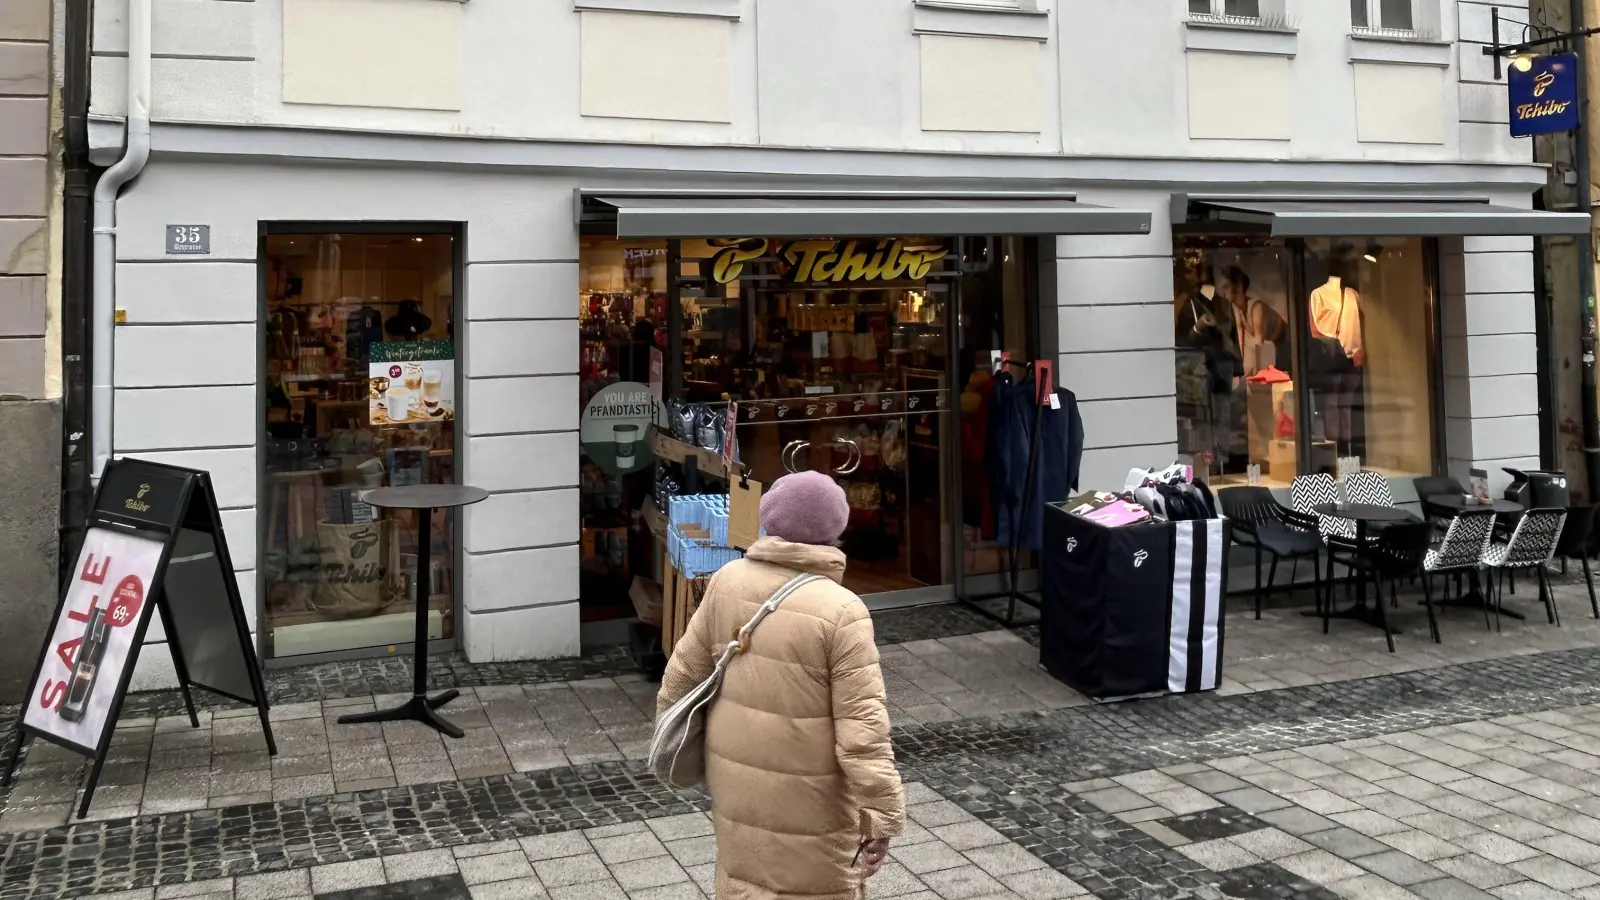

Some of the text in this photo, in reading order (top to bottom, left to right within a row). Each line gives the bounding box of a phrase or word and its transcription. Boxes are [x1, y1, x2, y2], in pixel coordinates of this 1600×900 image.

[1516, 99, 1571, 120] Tchibo
[175, 226, 200, 244] 35
[784, 239, 950, 283] Tchibo
[604, 391, 648, 404] YOU ARE
[590, 403, 659, 417] PFANDTASTIC
[125, 498, 150, 512] Tchibo
[40, 553, 111, 713] SALE
